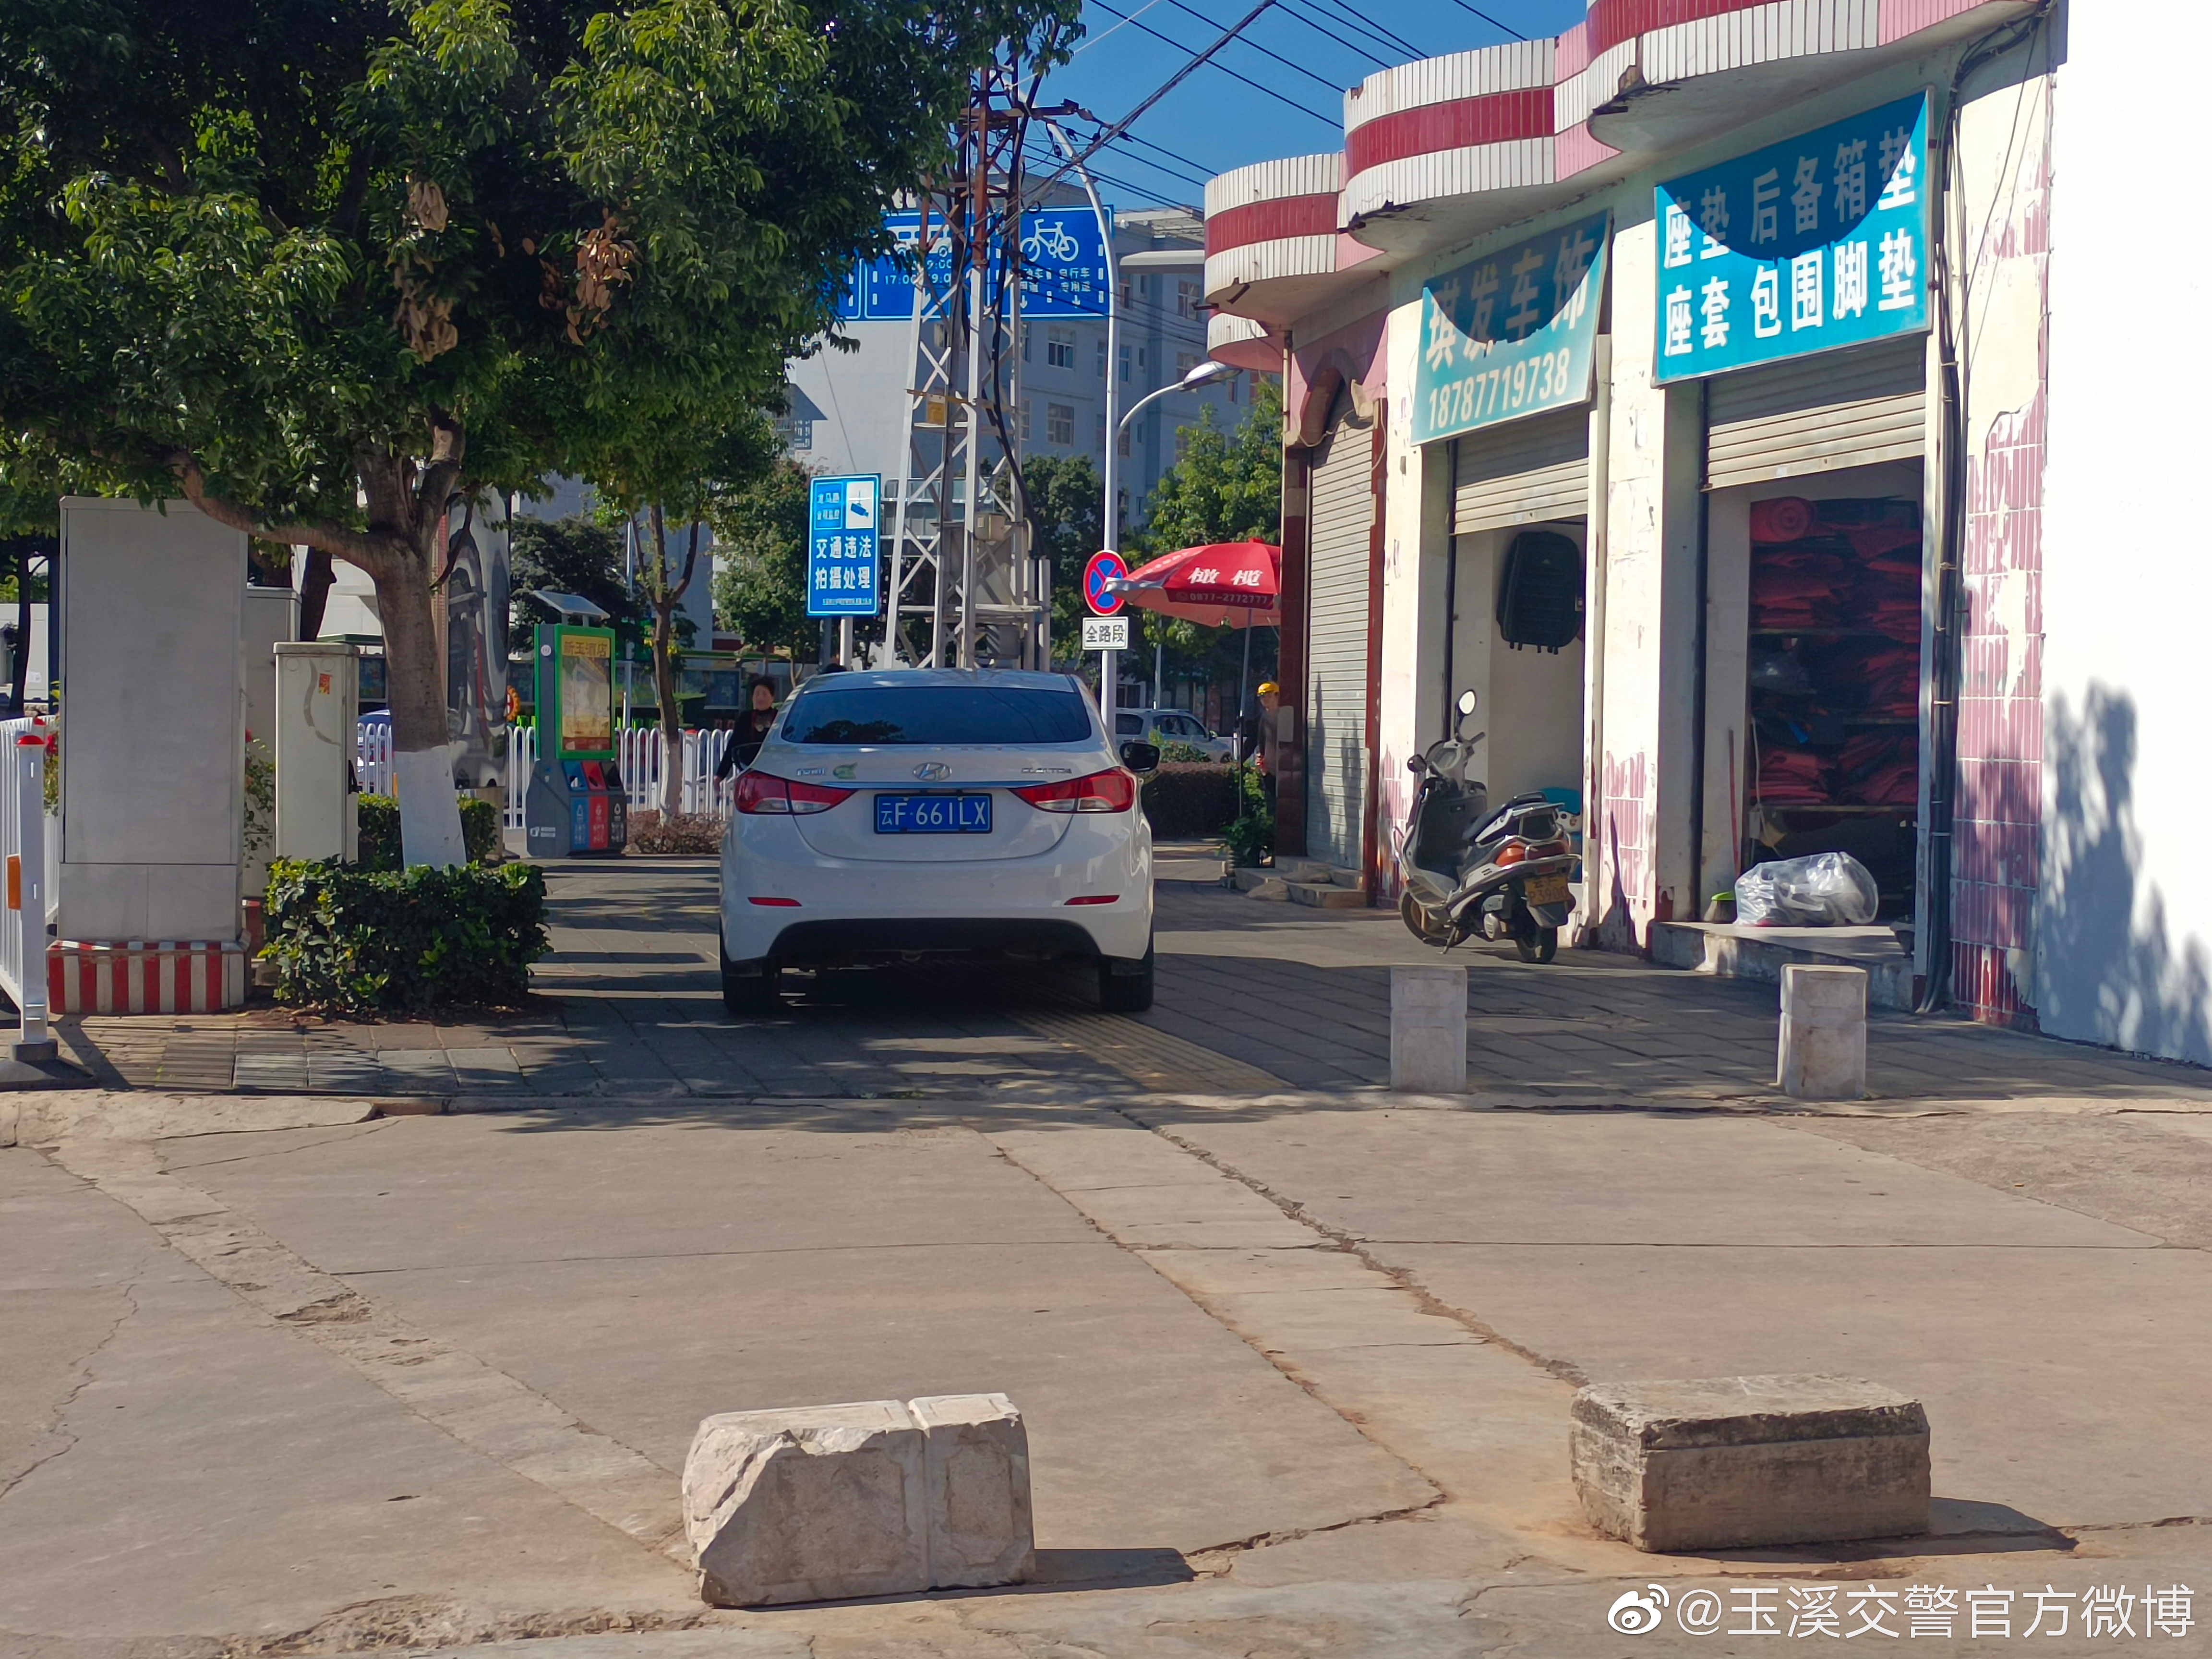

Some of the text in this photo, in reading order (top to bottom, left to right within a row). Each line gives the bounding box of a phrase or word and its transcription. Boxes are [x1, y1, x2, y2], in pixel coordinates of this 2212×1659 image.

[1664, 126, 1917, 269] 座垫 后备箱垫
[1425, 229, 1595, 372] 琪发车饰
[1664, 228, 1917, 357] 座套 包围脚垫
[1429, 347, 1570, 431] 18787719738
[816, 535, 872, 559] 交通违法
[815, 566, 870, 590] 拍摄处理
[1190, 592, 1268, 604] 0877-2772777
[1086, 625, 1125, 643] 全路段
